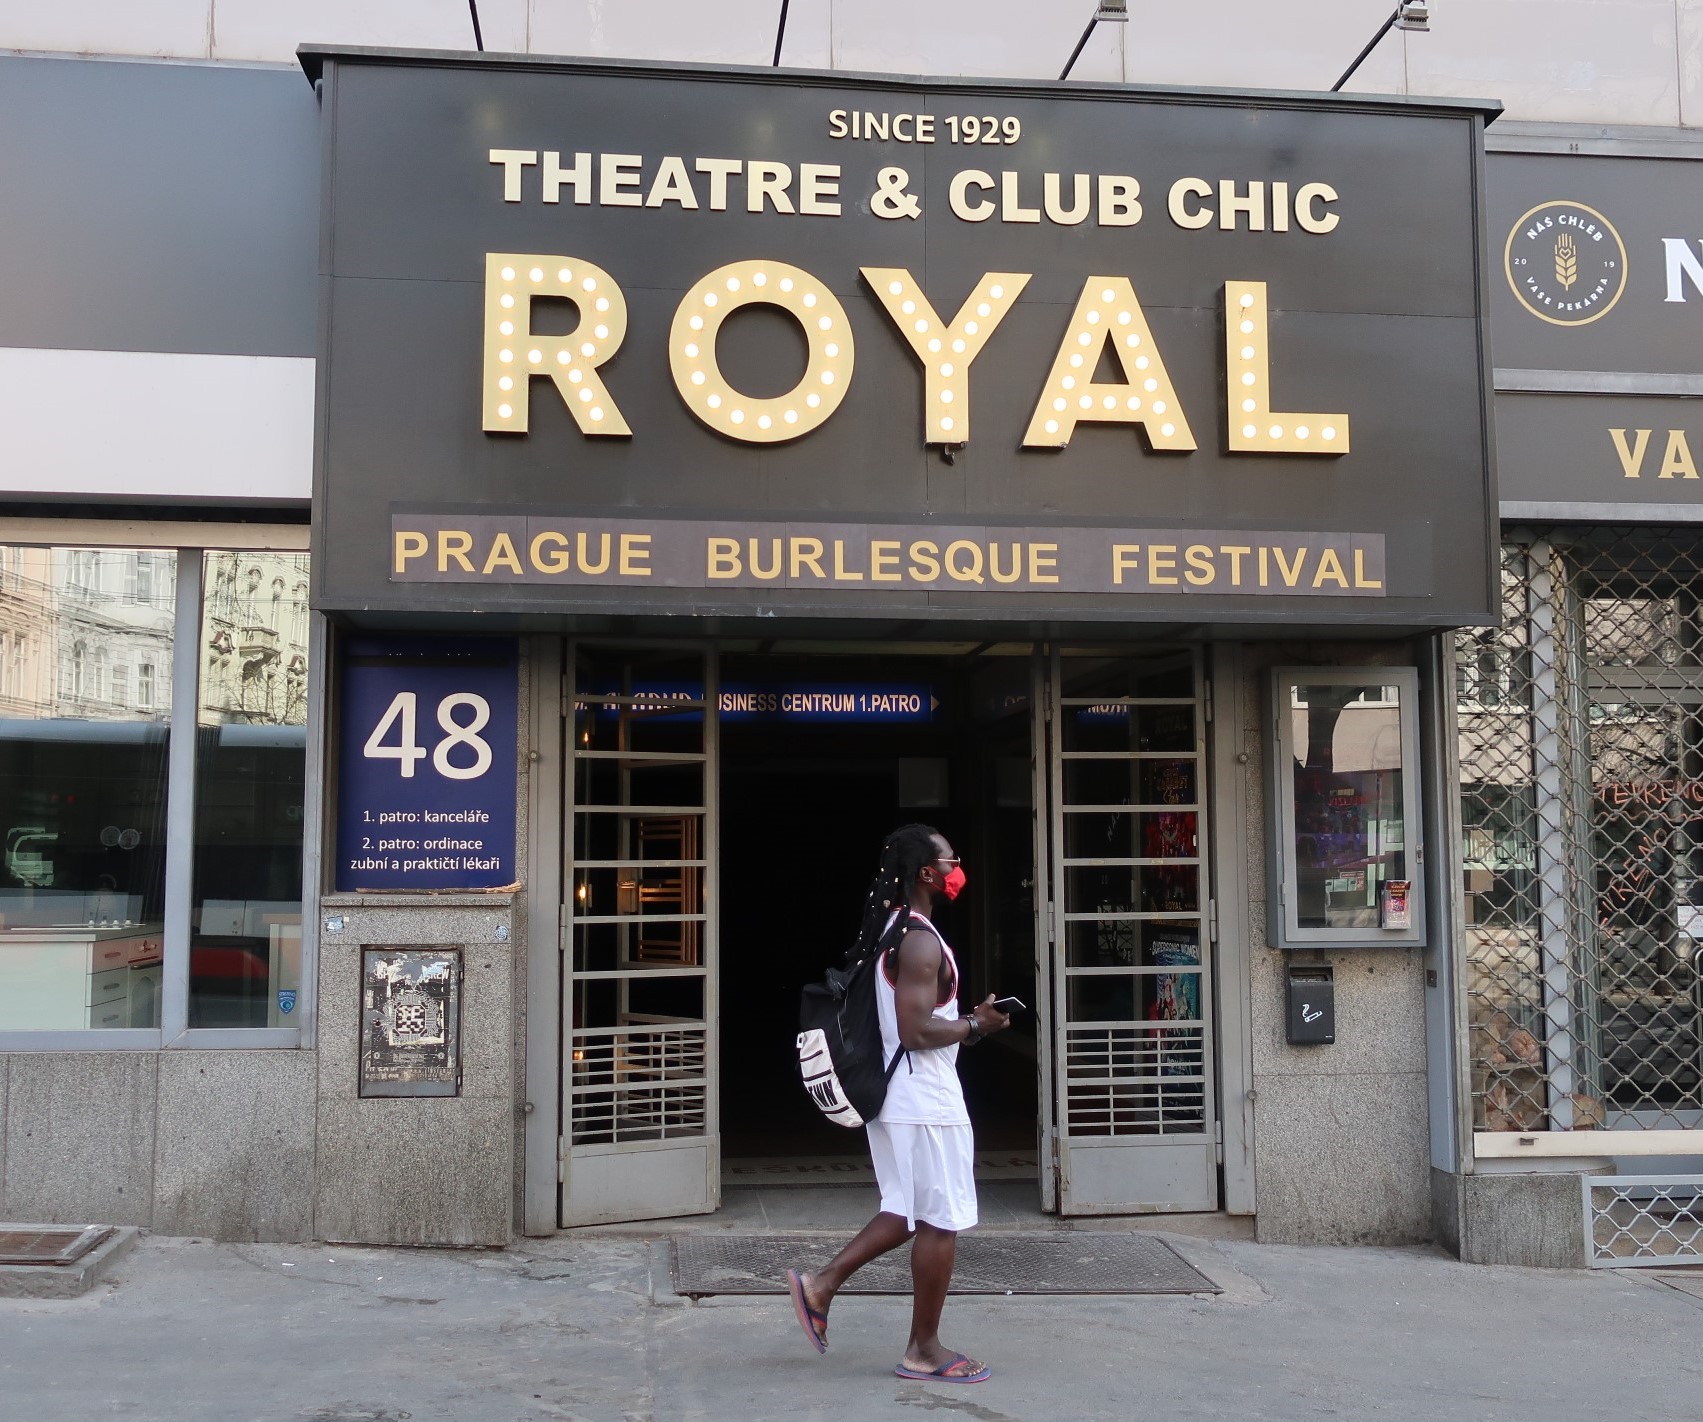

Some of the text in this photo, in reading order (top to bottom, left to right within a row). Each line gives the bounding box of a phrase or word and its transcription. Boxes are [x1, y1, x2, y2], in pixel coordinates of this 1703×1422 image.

[829, 109, 1022, 145] SINCE 1929
[488, 148, 1341, 235] THEATRE & CLUB CHIC
[482, 252, 1350, 453] ROYAL
[1607, 428, 1700, 479] VA
[395, 530, 1382, 590] PRAGUE BURLESQUE FESTIVAL
[718, 693, 777, 712] SINESS
[781, 693, 855, 713] CENTRUM
[363, 691, 493, 780] 48
[363, 808, 489, 825] 1. patro: kanceláře
[350, 855, 500, 873] zubní a praktičtí lékaři
[362, 836, 483, 852] 2. patro: ordinace
